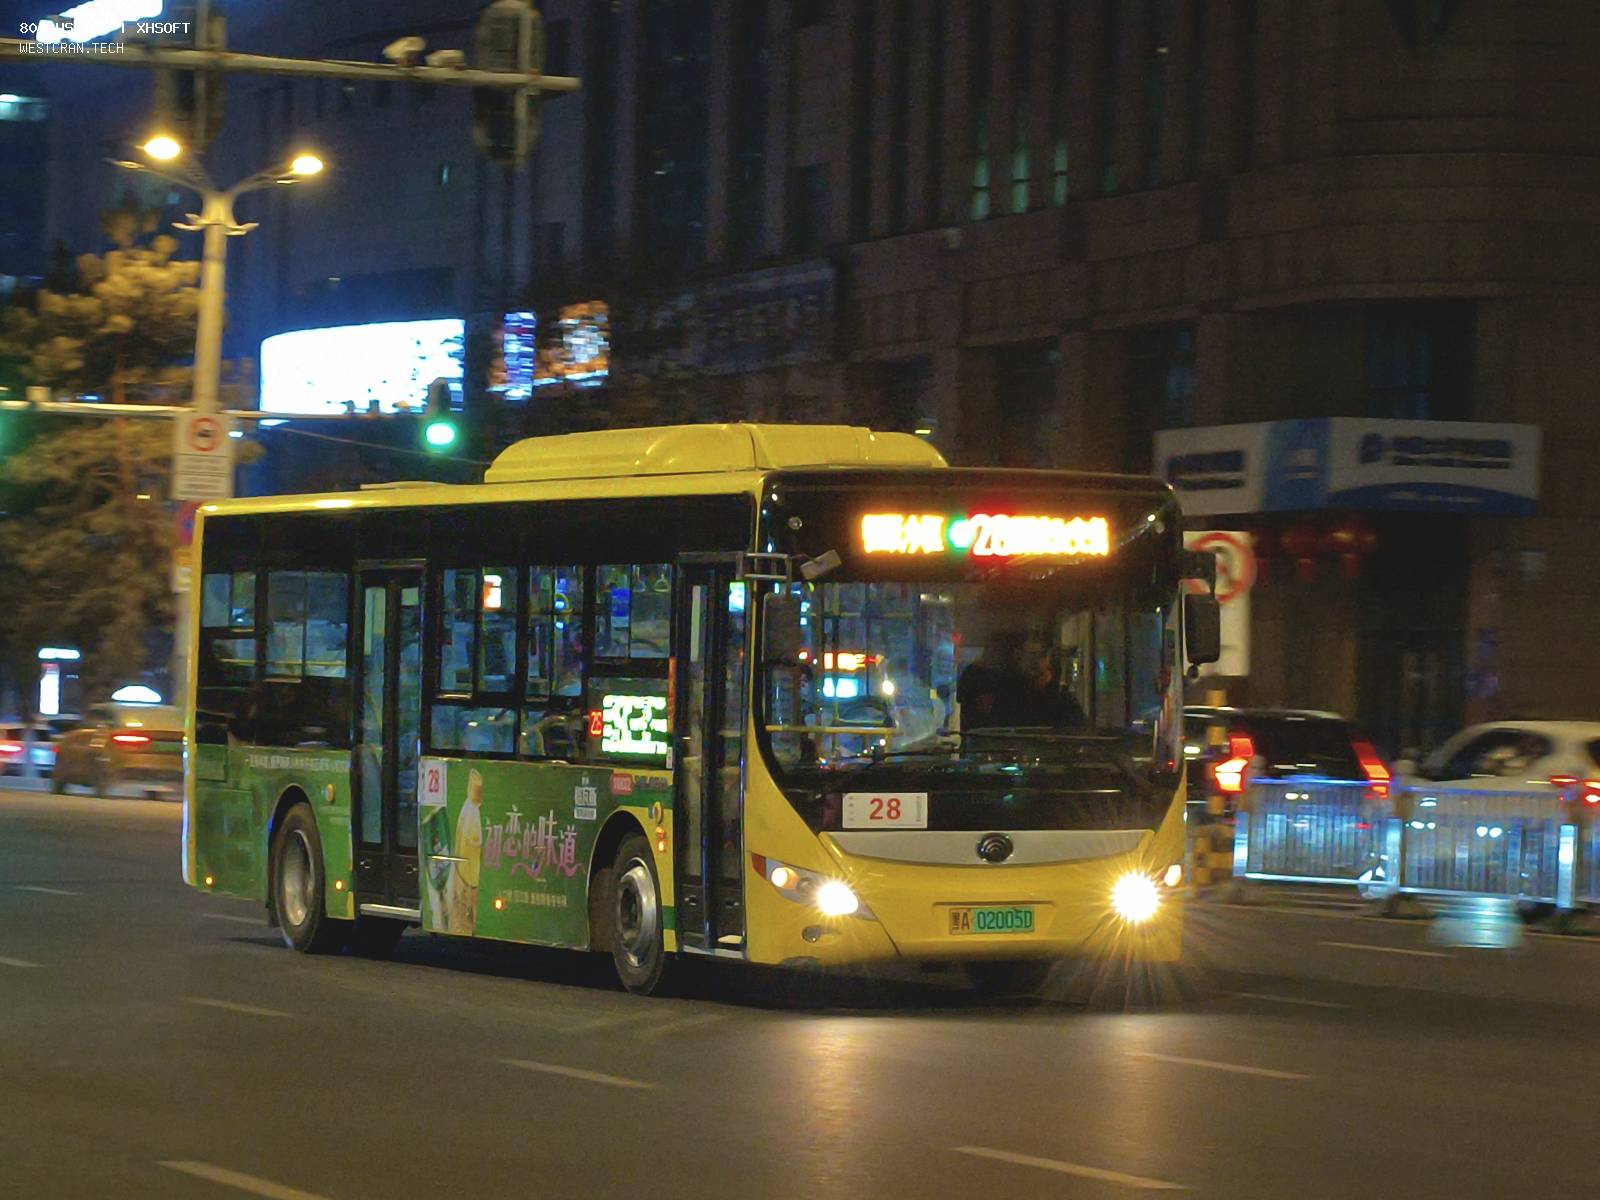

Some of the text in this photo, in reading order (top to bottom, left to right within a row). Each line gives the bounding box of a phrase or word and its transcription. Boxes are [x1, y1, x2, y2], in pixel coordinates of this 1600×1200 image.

[428, 769, 440, 793] 28
[869, 797, 901, 820] 28
[484, 805, 584, 878] 初恋的味道
